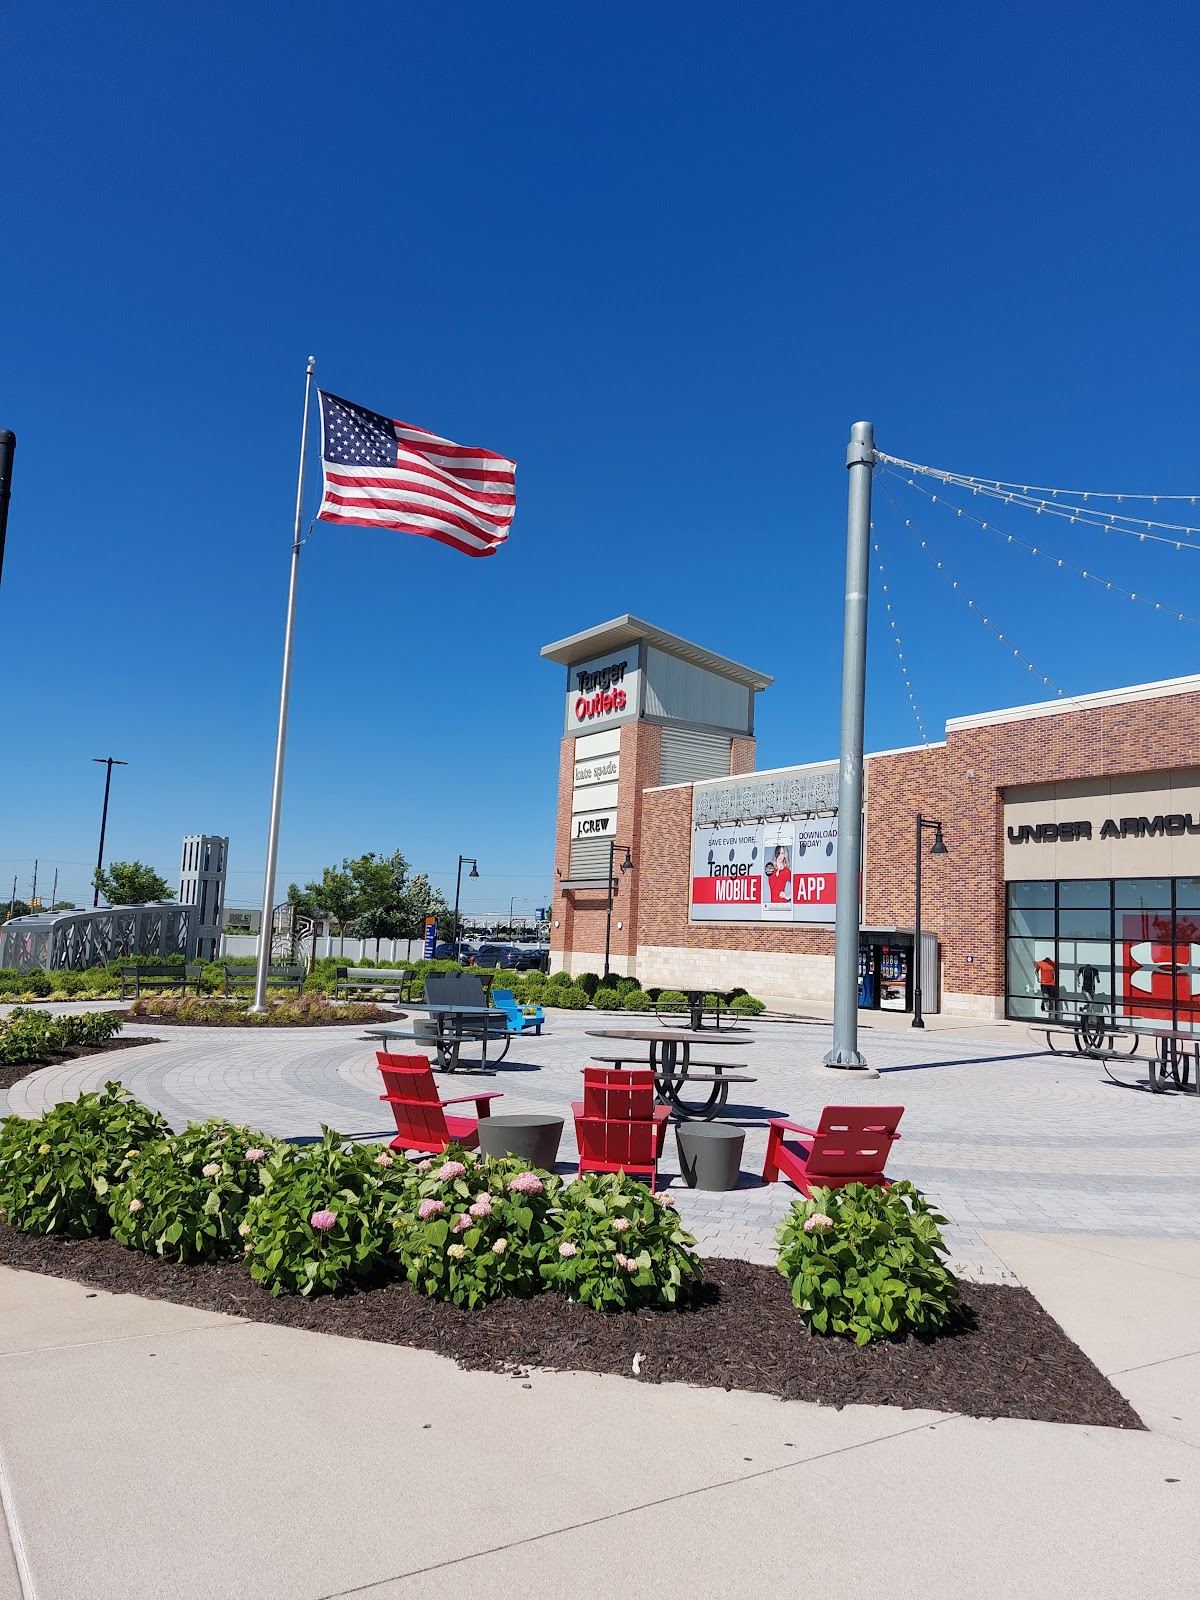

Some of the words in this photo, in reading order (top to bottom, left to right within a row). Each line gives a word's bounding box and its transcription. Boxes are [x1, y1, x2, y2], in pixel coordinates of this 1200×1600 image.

[576, 661, 628, 695] Tanger
[575, 688, 627, 721] Outlets
[575, 765, 592, 781] kate
[593, 761, 617, 781] spade
[708, 839, 722, 847] SAVE
[723, 838, 738, 846] EVEN
[799, 830, 837, 840] DOWNLOAD
[1007, 820, 1093, 845] UNDER
[799, 840, 821, 848] TODAY!
[708, 861, 753, 880] Tanger
[715, 879, 757, 901] MOBILE
[797, 877, 825, 901] APP
